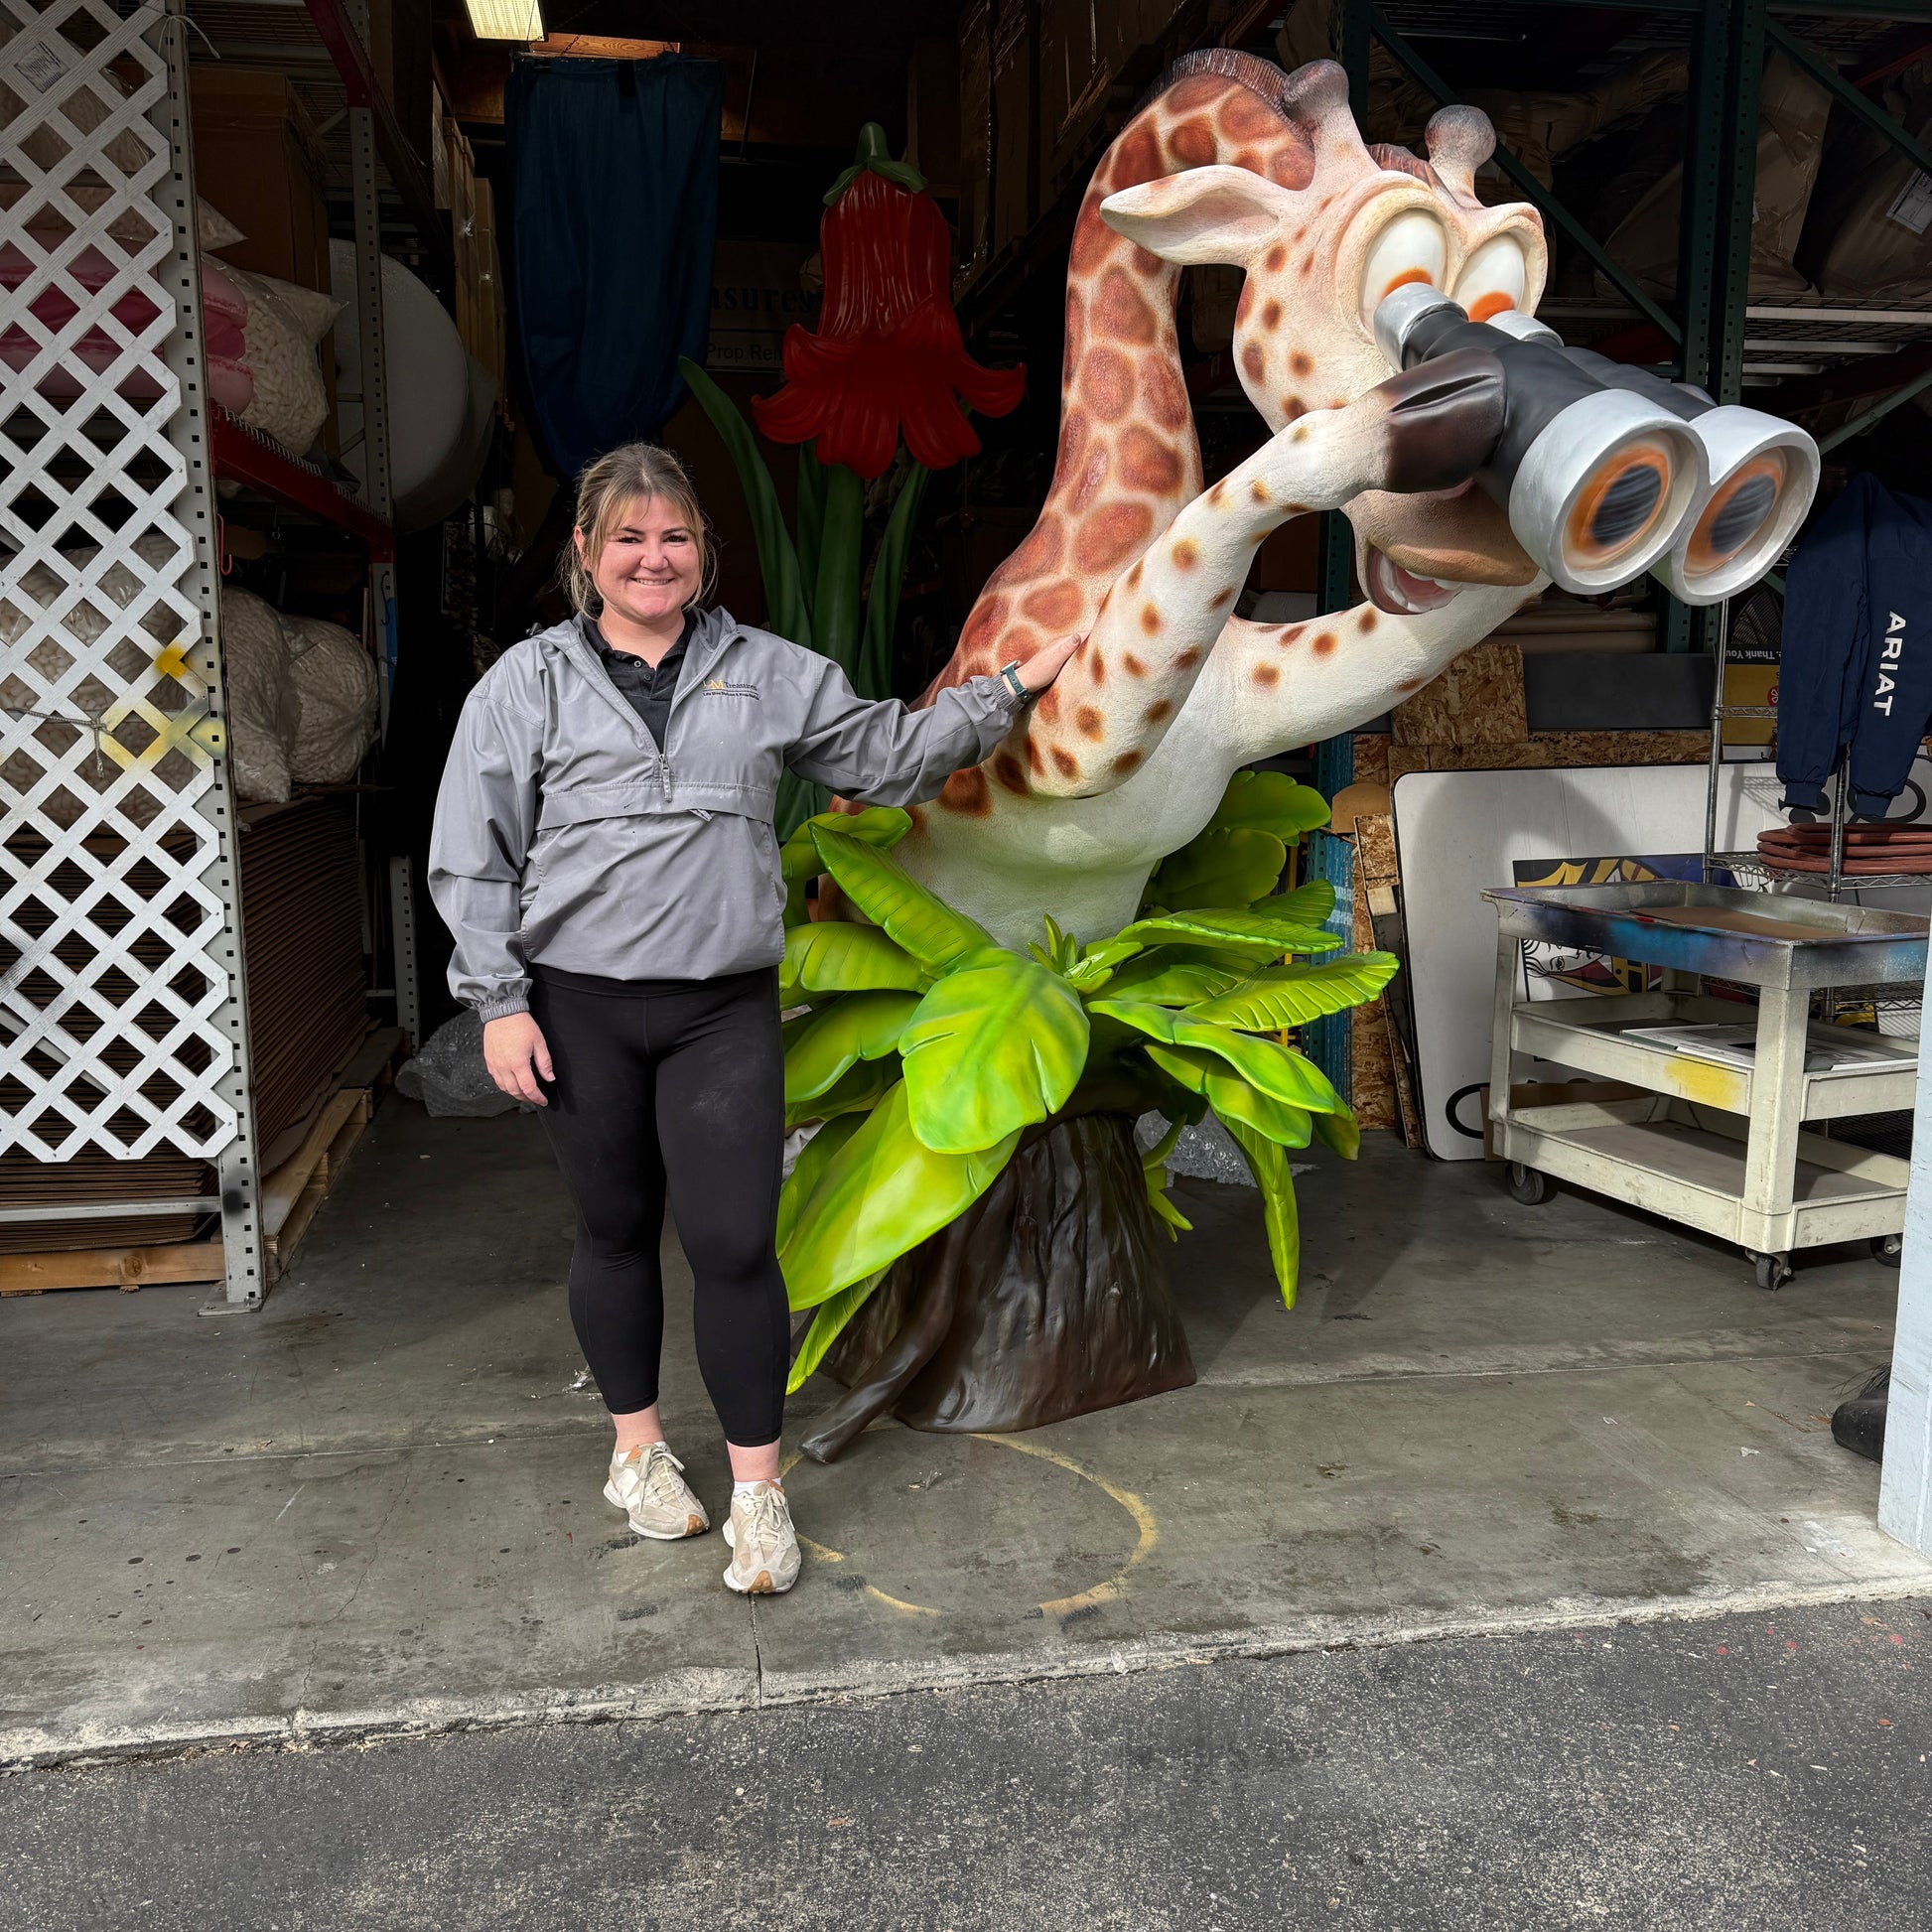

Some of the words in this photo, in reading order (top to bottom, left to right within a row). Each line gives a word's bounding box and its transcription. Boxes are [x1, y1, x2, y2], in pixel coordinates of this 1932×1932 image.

[706, 343, 744, 362] Prop
[1725, 649, 1745, 660] You
[1744, 649, 1776, 660] Thank
[1873, 611, 1906, 717] ARIAT
